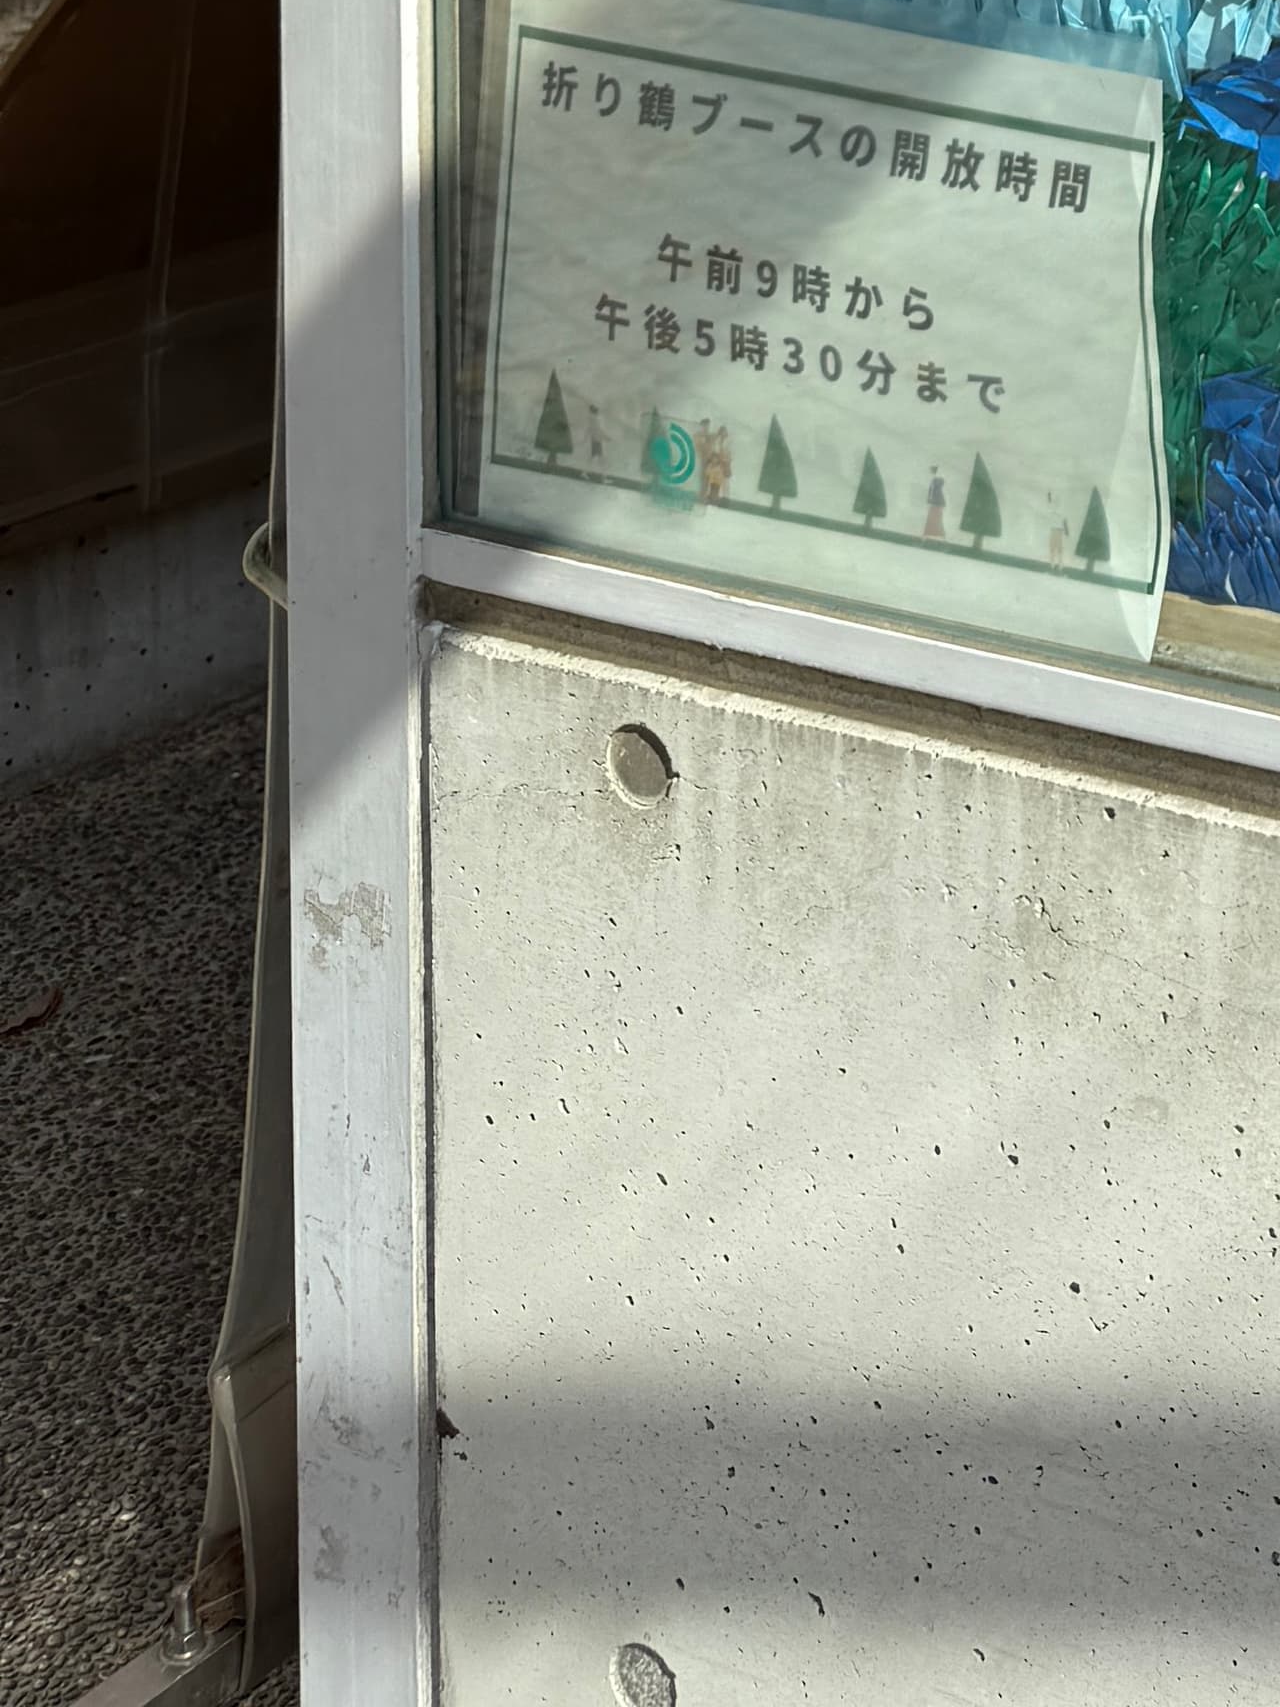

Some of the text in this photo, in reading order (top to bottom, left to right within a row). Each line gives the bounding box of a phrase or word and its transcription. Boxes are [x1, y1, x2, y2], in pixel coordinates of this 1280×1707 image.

[540, 59, 1093, 215] 折り鶴ブースの開放時間
[656, 232, 936, 333] 午前9時から
[593, 293, 1007, 415] 午後5時30分まで
